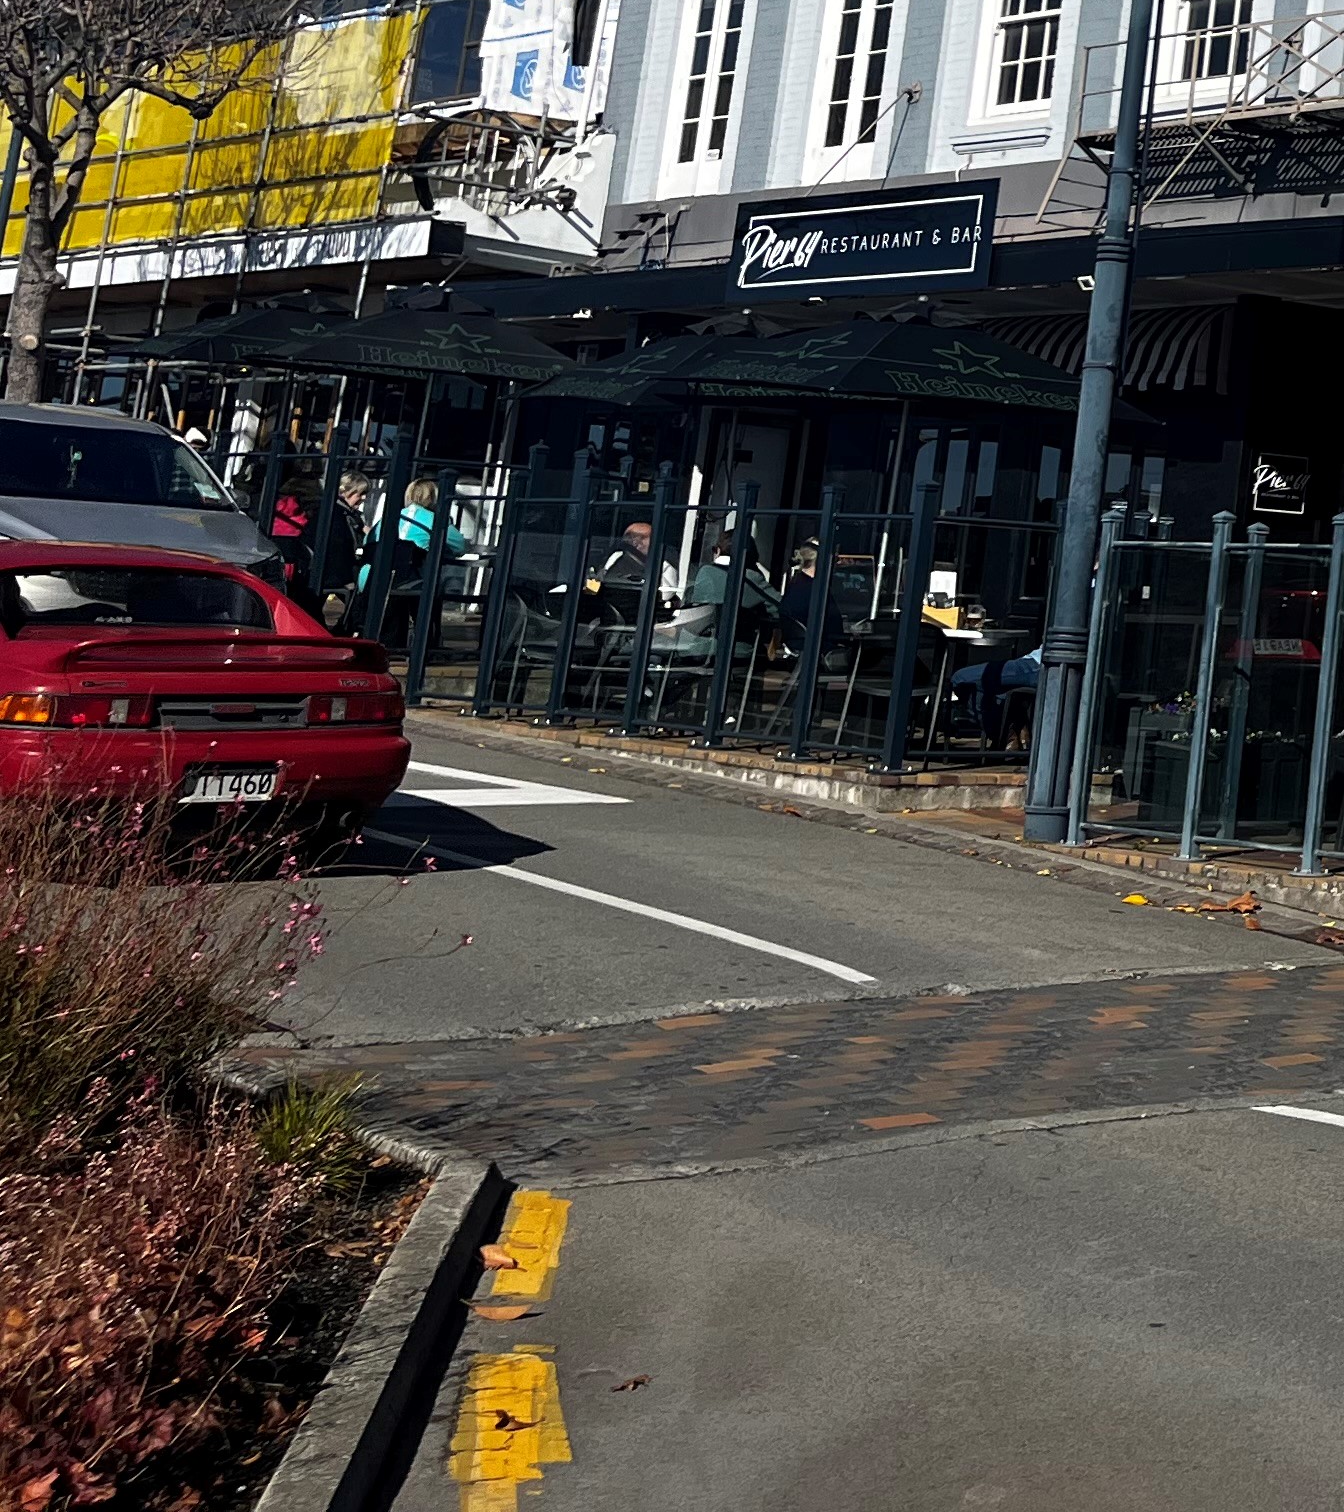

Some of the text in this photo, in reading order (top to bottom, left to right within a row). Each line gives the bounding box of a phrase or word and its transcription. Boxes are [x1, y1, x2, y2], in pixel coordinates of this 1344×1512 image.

[820, 230, 924, 255] RESTAURANT
[931, 228, 942, 245] &
[951, 225, 983, 244] BAR
[884, 370, 1081, 411] Heineke
